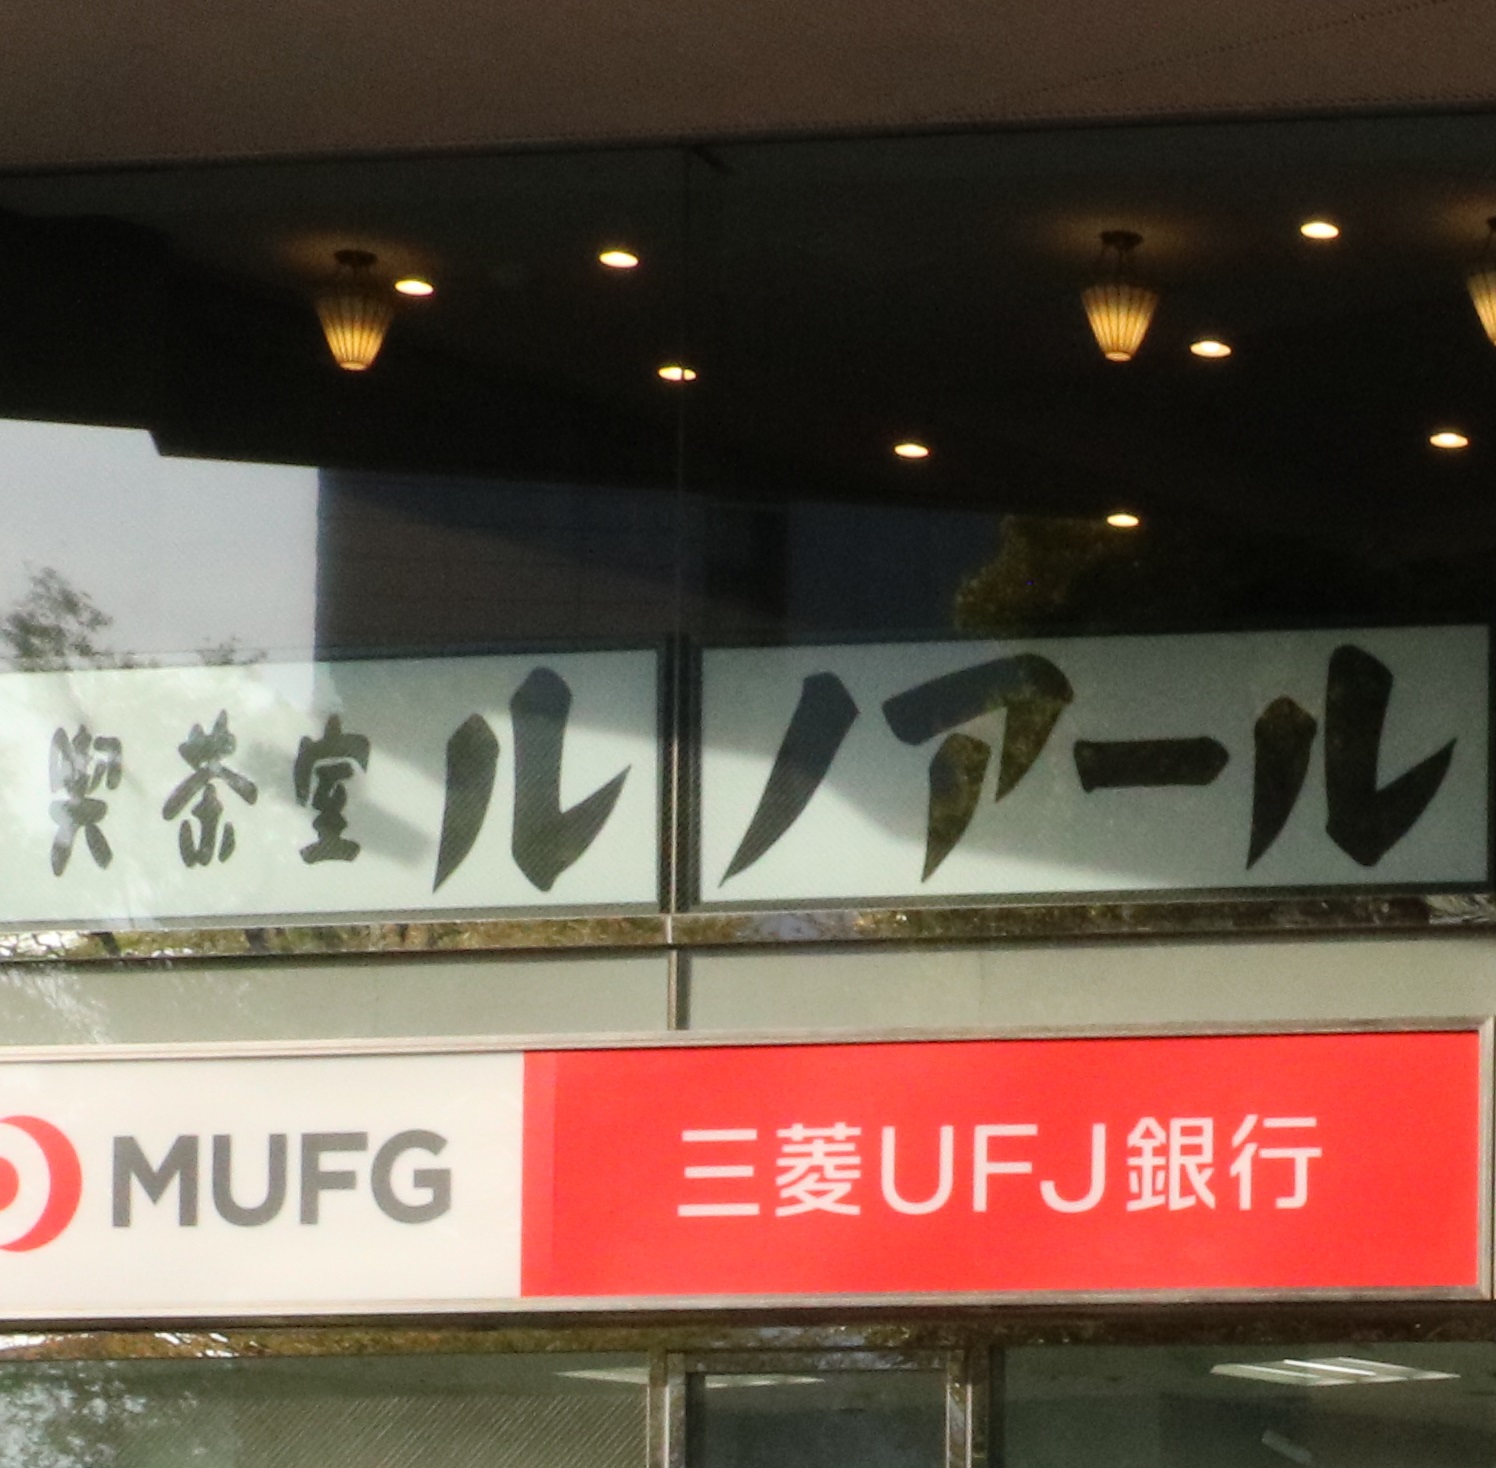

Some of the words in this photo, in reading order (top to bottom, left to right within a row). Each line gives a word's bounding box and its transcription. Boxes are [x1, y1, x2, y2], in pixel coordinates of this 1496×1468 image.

[49, 709, 370, 876] 喫茶室
[432, 644, 1456, 892] ルノアール
[112, 1129, 451, 1228] MUFG
[677, 1117, 1322, 1218] 三菱UFJ銀行
